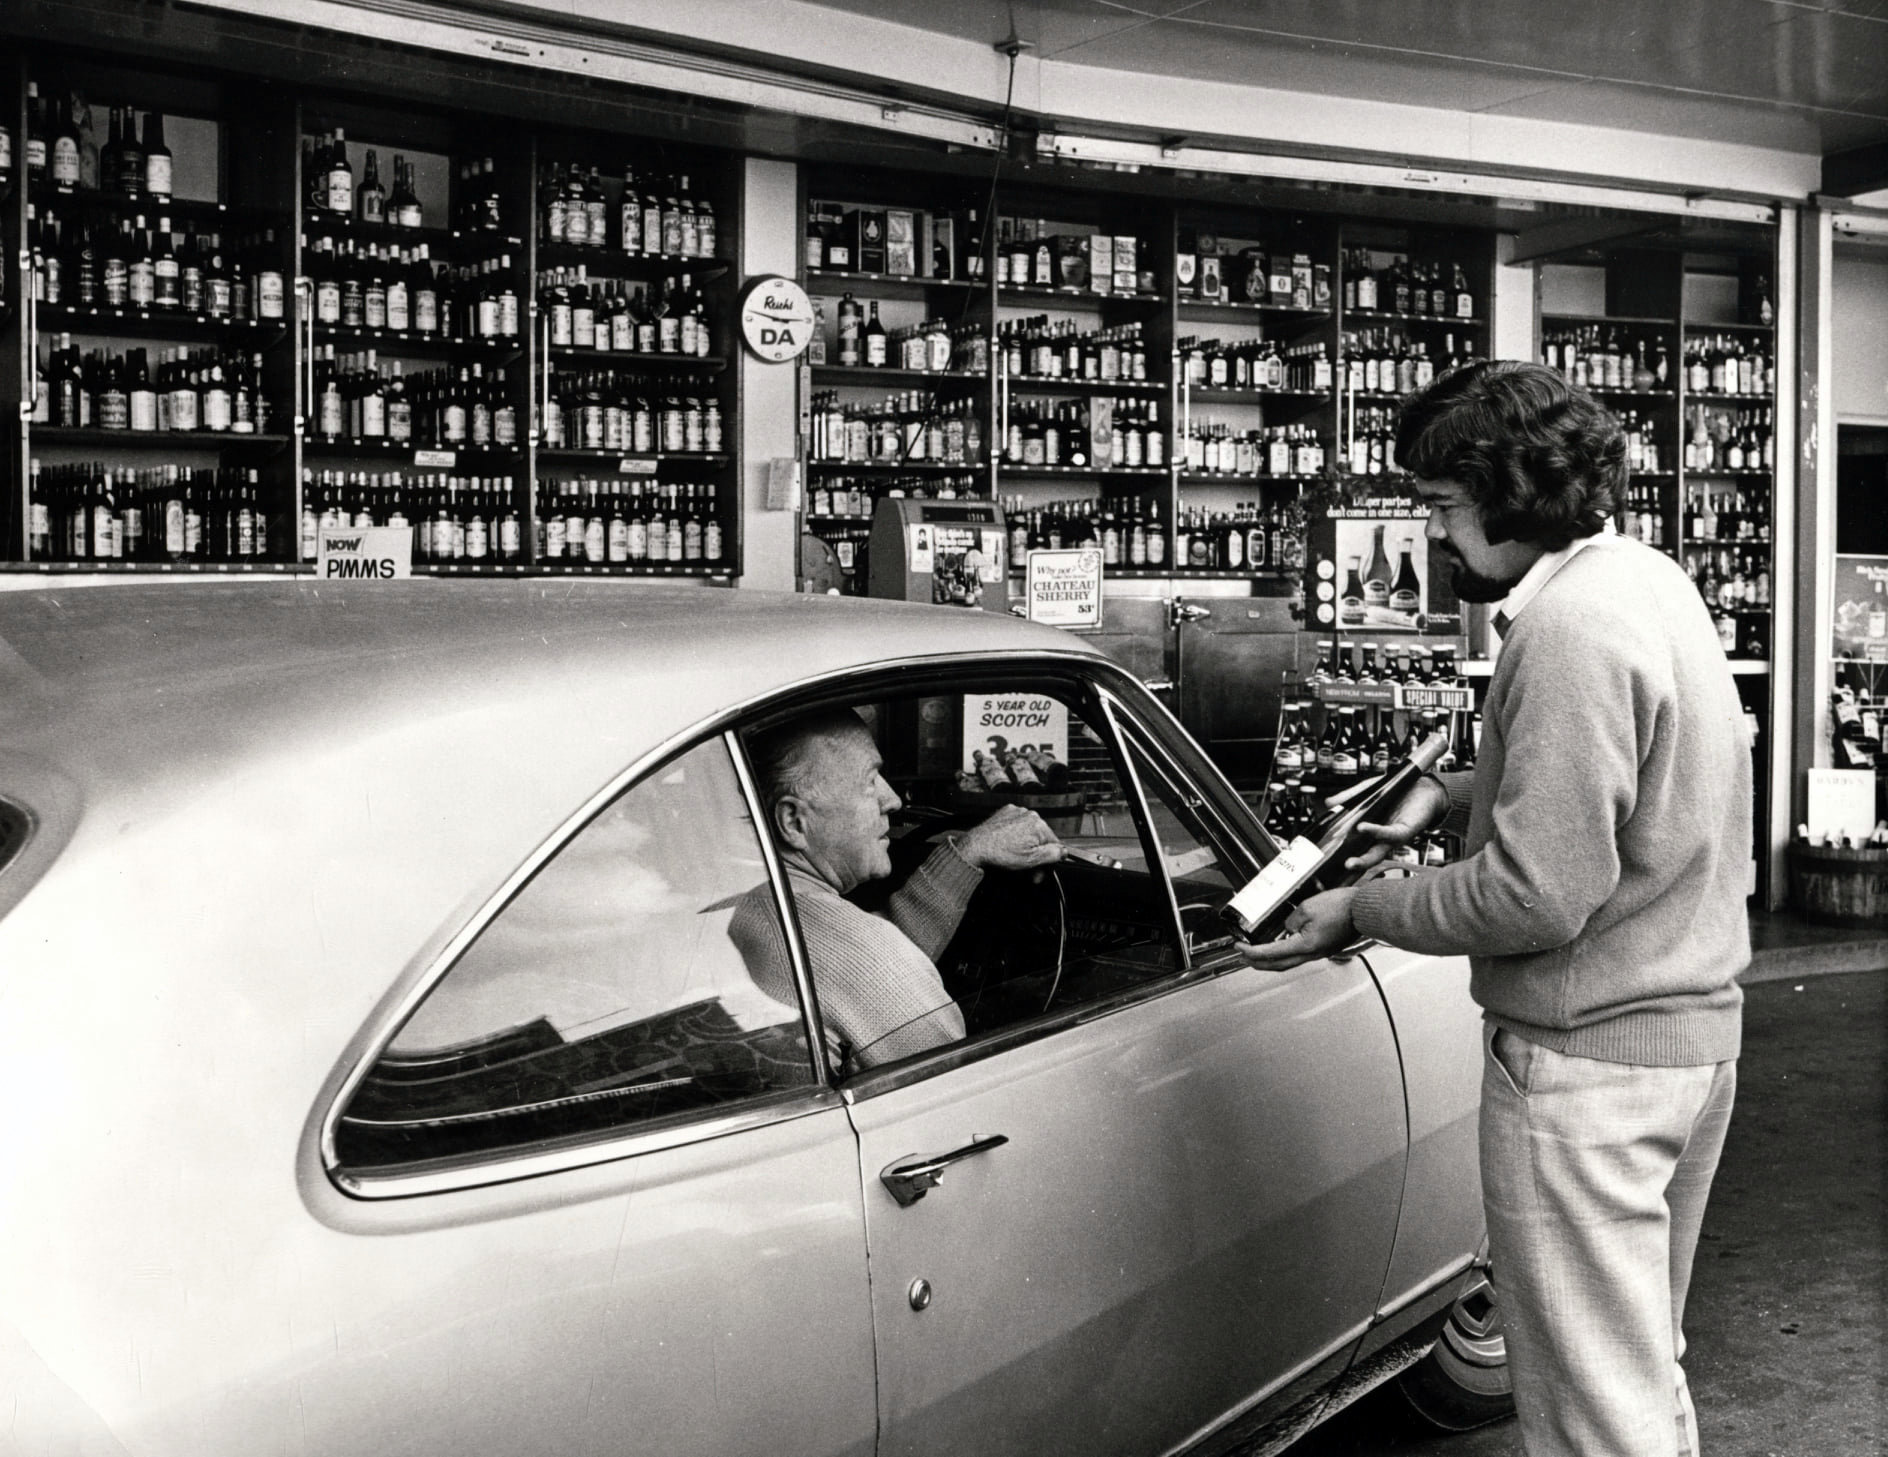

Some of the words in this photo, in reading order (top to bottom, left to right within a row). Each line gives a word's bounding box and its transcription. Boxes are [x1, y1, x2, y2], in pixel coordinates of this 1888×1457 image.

[761, 328, 796, 346] DA
[1326, 504, 1346, 518] don't
[1346, 509, 1367, 518] come
[1368, 508, 1377, 518] in
[1378, 508, 1393, 518] one
[326, 537, 362, 552] NOW
[327, 558, 395, 579] PIMMS
[1033, 580, 1096, 592] CHATEAU
[1036, 591, 1091, 602] SHERRY
[983, 700, 993, 711] 5
[997, 700, 1026, 711] YEAR
[1029, 700, 1052, 711] OLD
[1406, 690, 1437, 706] SPECIAL
[1441, 691, 1465, 707] VALUE
[979, 713, 1051, 727] SCOTCH
